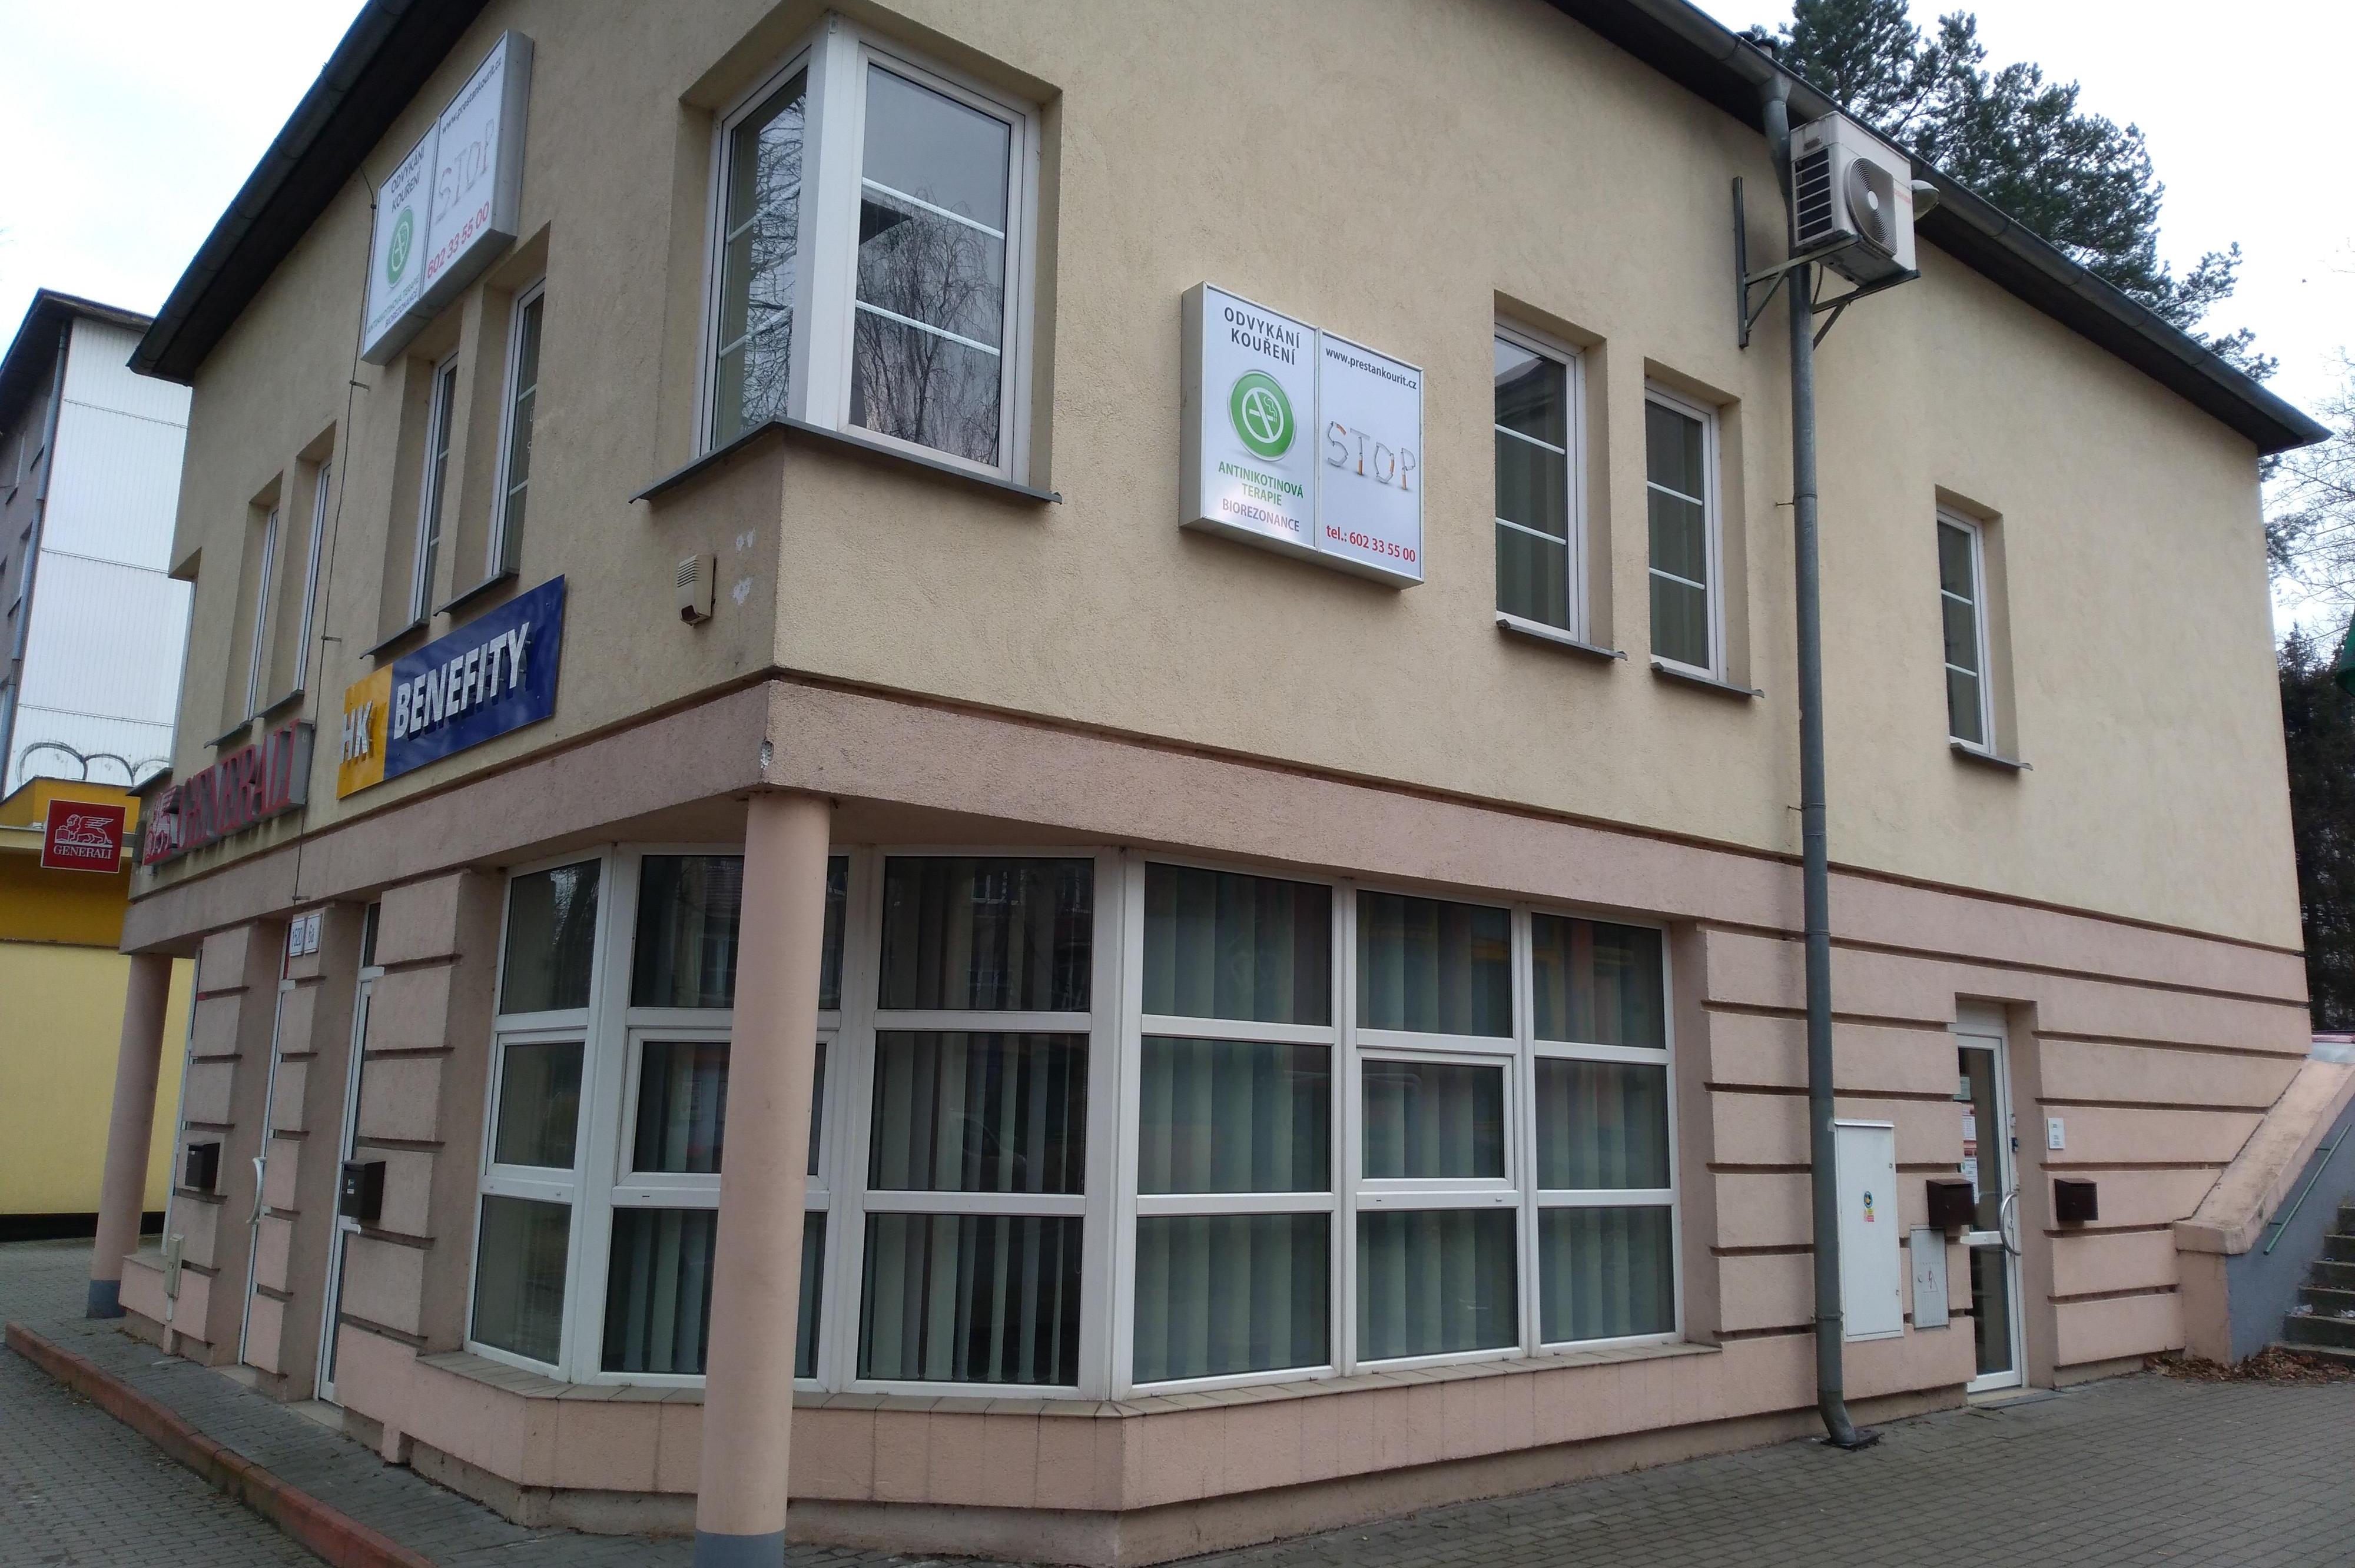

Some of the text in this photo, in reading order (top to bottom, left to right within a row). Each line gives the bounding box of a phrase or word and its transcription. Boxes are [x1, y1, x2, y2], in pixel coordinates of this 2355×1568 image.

[391, 141, 425, 194] ODVYKÁNÍ
[437, 119, 495, 219] STOP
[392, 165, 421, 213] KOUŘENÍ
[427, 201, 489, 279] 602 33 55 00
[1224, 307, 1300, 348] ODVYKÁNÍ
[1231, 328, 1295, 365] KOUŘENÍ
[1326, 348, 1417, 390] www.prestankourit.cz
[1326, 420, 1416, 490] STOP
[1218, 461, 1303, 499] ANTINIKOTINOVÁ
[1242, 483, 1282, 506] TERAPIE
[1223, 499, 1300, 532] BIOREZONANCE
[1326, 525, 1415, 562] tel.: 602 33 55 00
[340, 622, 530, 764] HK BENEFITY
[54, 845, 112, 859] GENERALI
